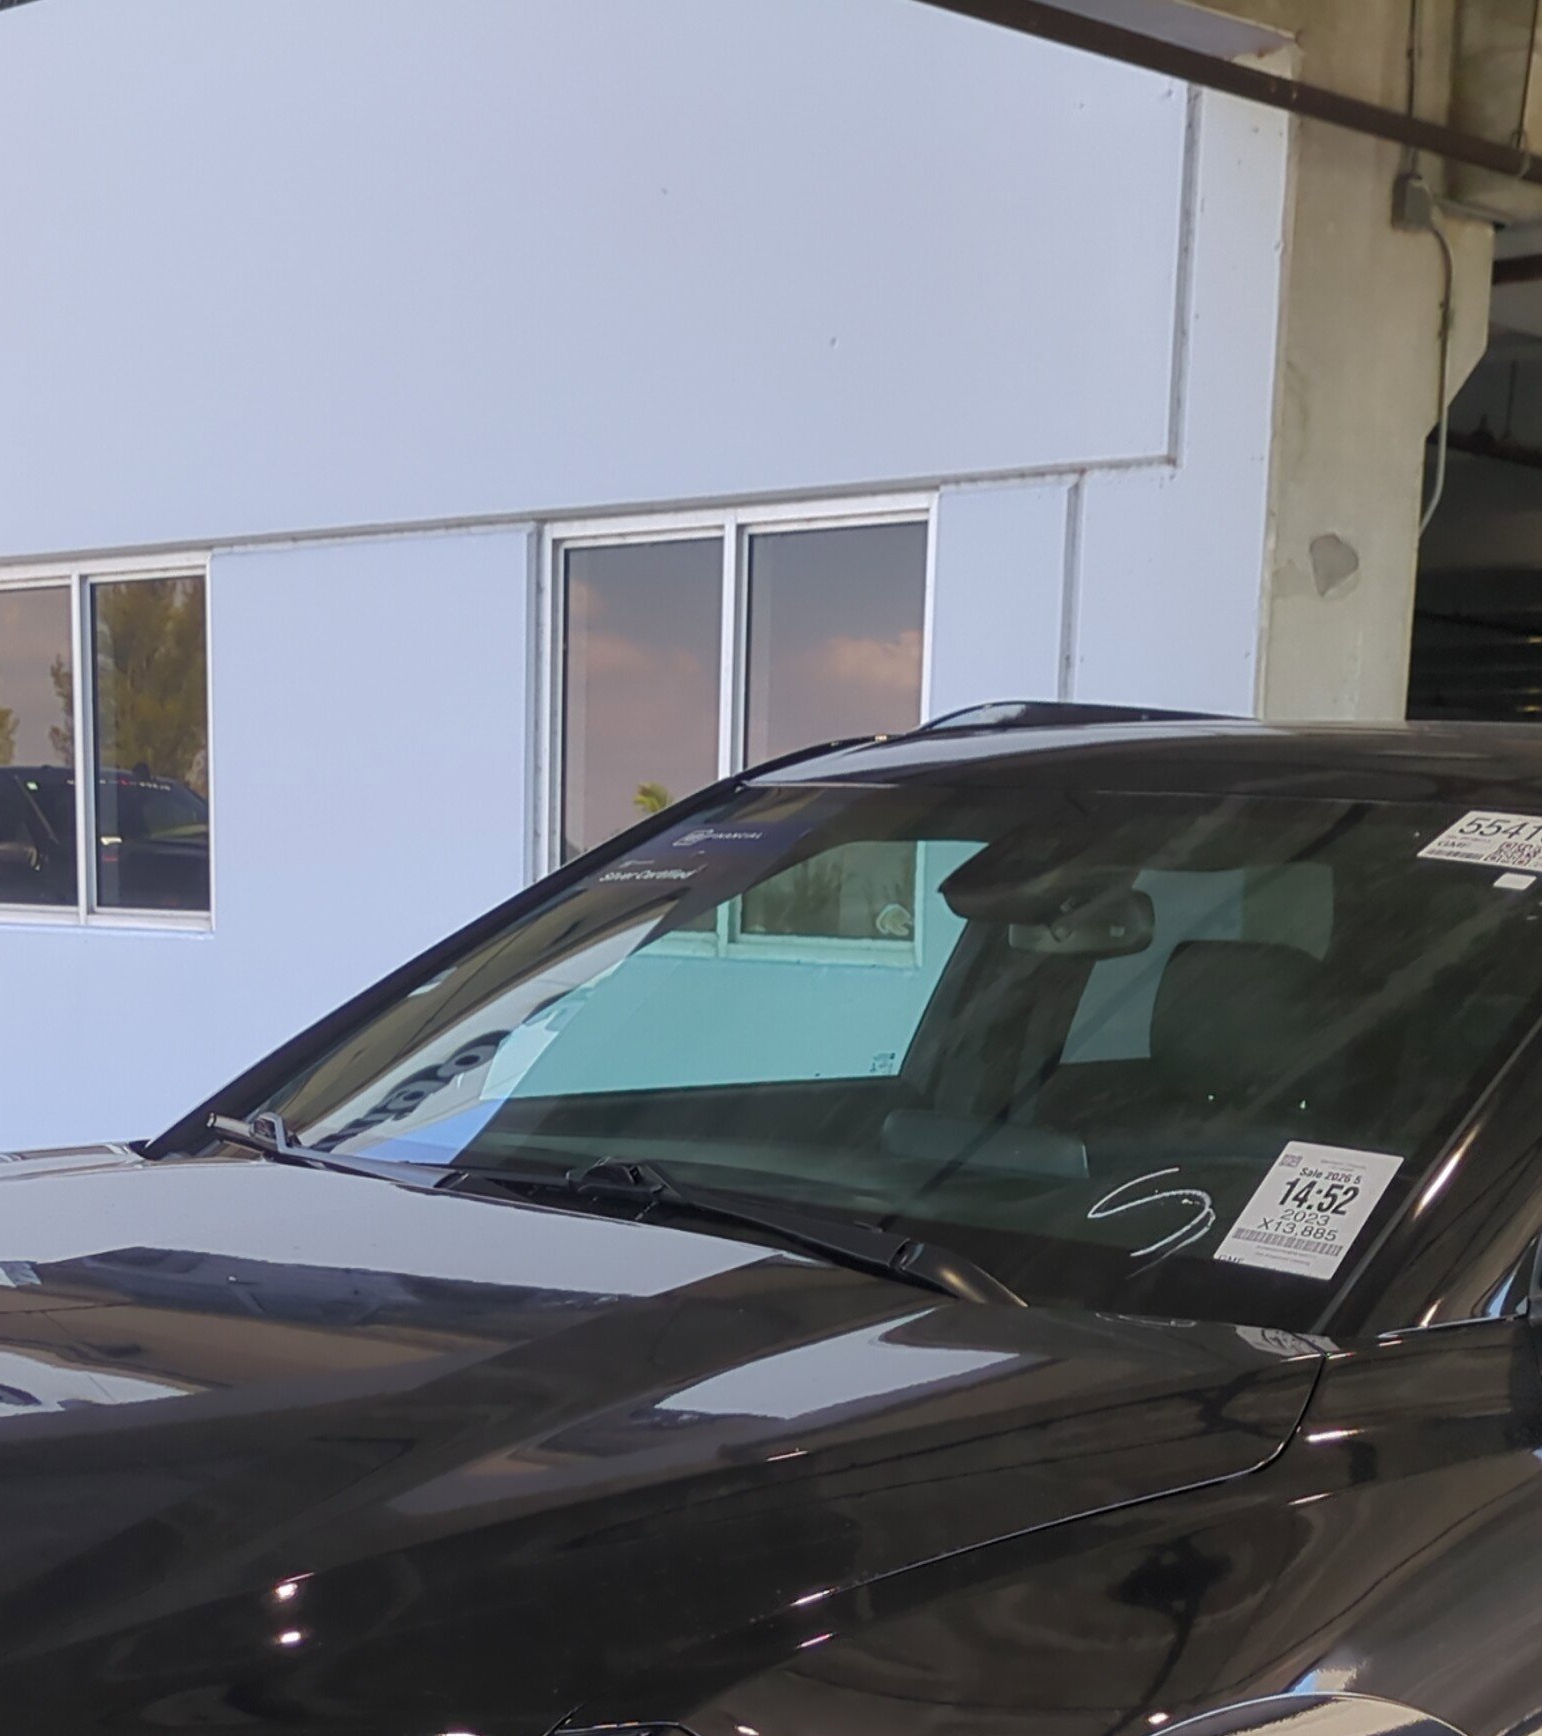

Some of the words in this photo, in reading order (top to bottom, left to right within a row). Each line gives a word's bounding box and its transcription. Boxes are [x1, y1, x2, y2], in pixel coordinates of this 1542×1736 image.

[1299, 1167, 1323, 1179] Sale
[1278, 1178, 1361, 1216] 14:52
[1279, 1208, 1331, 1227] 2023
[1257, 1217, 1339, 1242] X13,885
